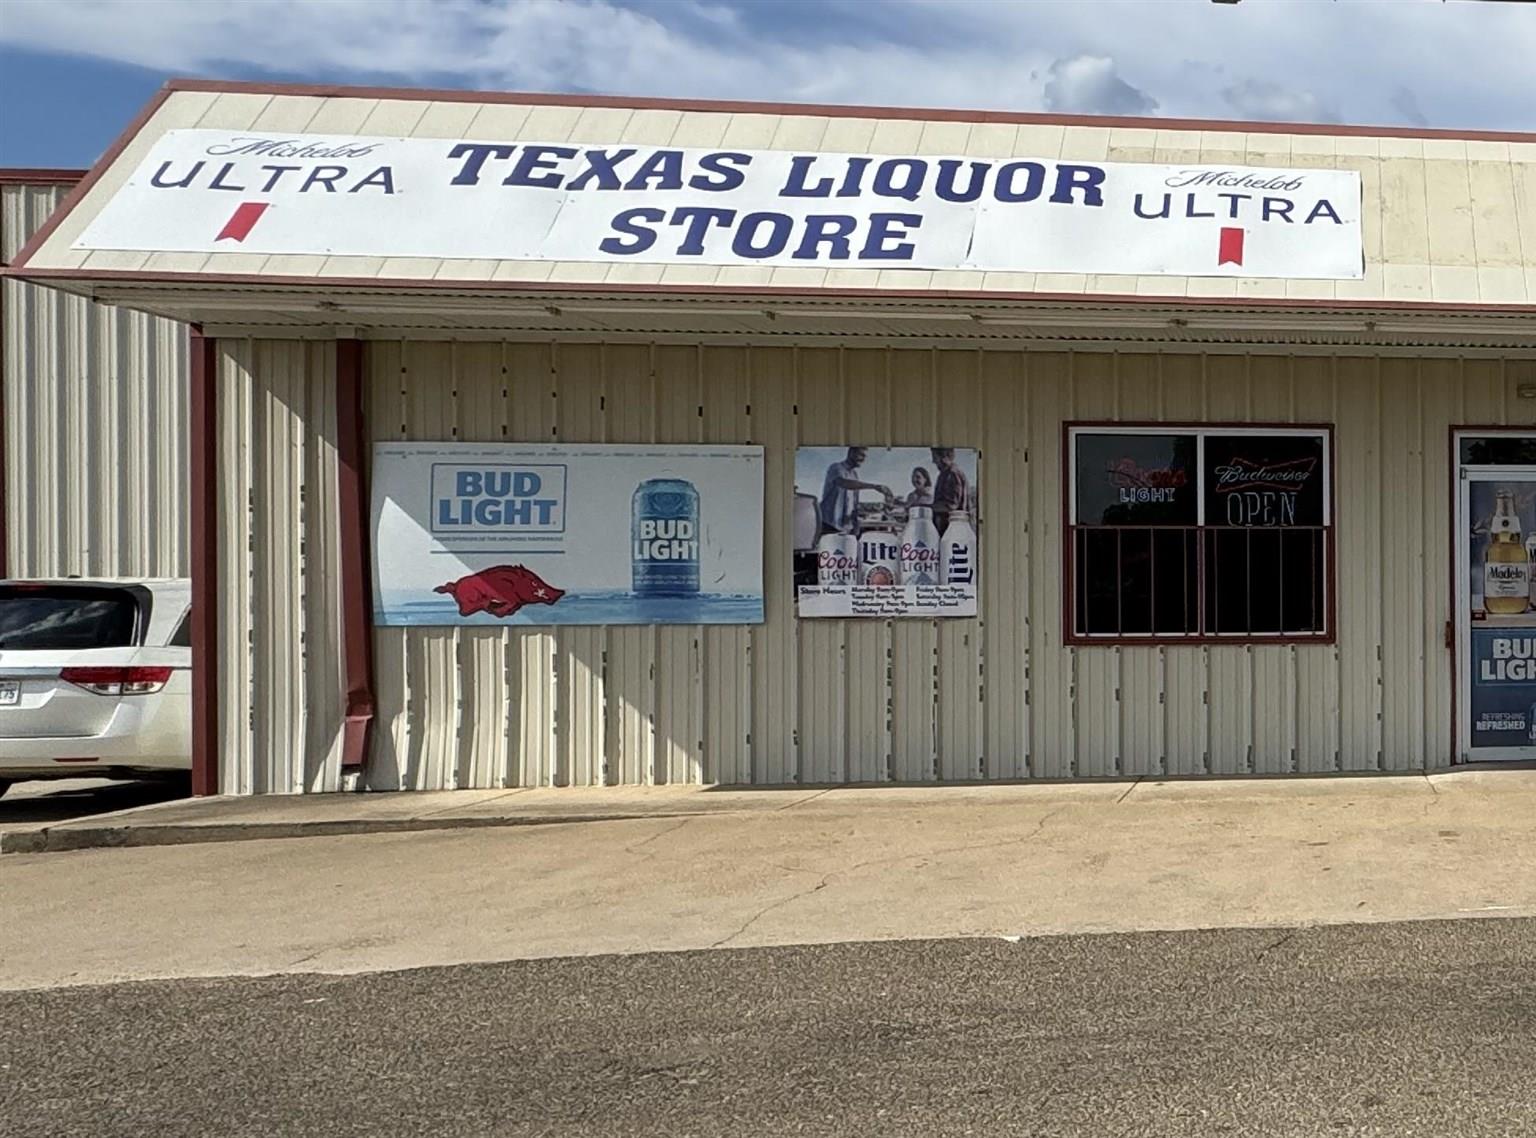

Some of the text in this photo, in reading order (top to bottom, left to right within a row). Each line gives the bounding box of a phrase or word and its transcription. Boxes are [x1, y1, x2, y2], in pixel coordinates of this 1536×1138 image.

[203, 137, 376, 160] Michelob
[150, 160, 395, 195] ULTRA
[446, 144, 1106, 207] TEXAS LIQUOR
[1165, 169, 1303, 192] Michelob
[1132, 192, 1344, 225] ULTRA
[598, 206, 923, 261] STORE
[456, 471, 541, 497] BUD
[1214, 465, 1311, 484] Budweiser
[1120, 487, 1176, 503] LIGHT
[438, 499, 558, 526] LIGHT
[1227, 492, 1299, 527] OPEN
[640, 519, 693, 540] BUD
[634, 540, 698, 560] LIGHT
[862, 541, 898, 565] Lite
[820, 570, 856, 581] LIGHT
[902, 562, 939, 573] LIGHT
[1489, 566, 1523, 579] Modelo
